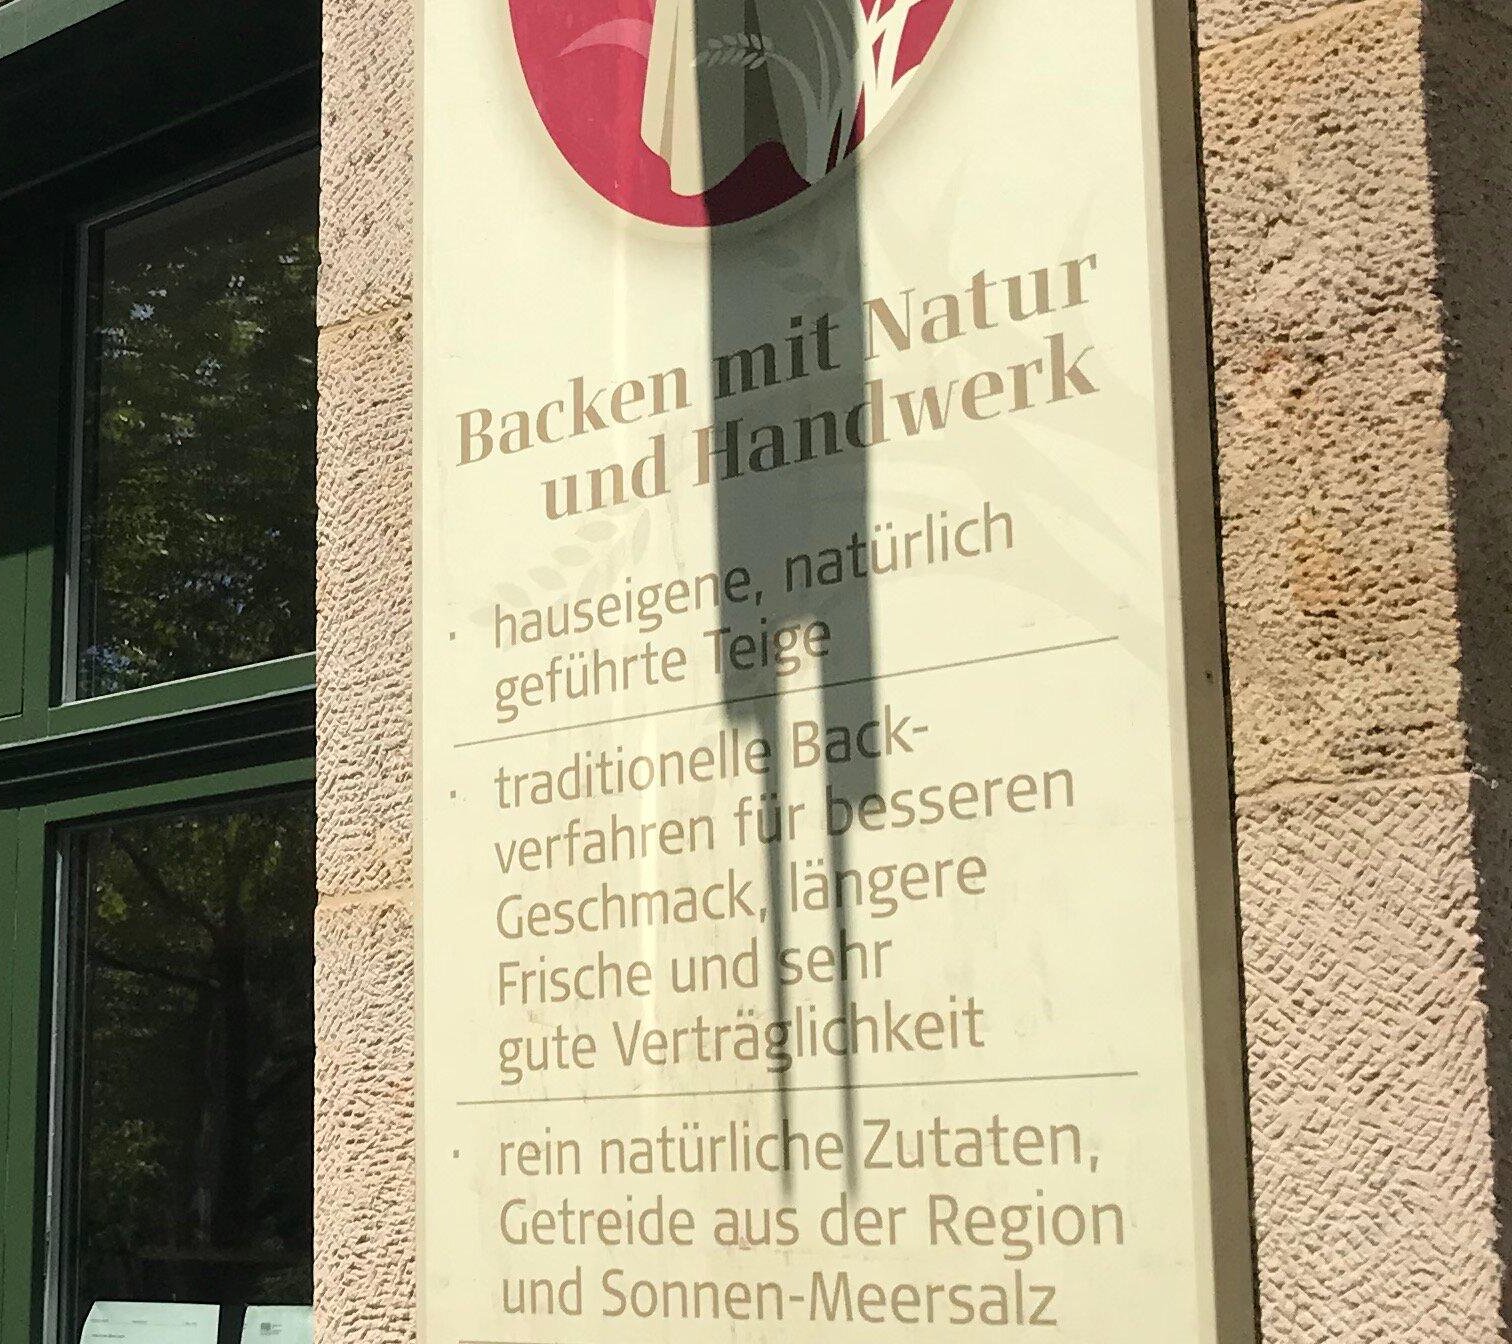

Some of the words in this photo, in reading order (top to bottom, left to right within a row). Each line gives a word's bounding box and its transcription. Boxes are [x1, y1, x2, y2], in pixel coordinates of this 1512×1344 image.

[456, 365, 692, 467] Backen
[713, 311, 842, 400] mit
[862, 253, 1099, 361] Natur
[541, 435, 674, 521] und
[692, 333, 1102, 488] Handwerk
[494, 555, 765, 649] hauseigene,
[785, 501, 1015, 591] natürlich
[494, 641, 688, 724] geführte
[704, 613, 832, 679] Teige
[494, 726, 772, 811] traditionelle
[792, 704, 930, 770] Back-
[494, 805, 716, 874] verfahren
[734, 785, 806, 845] für
[824, 764, 1074, 838] besseren
[496, 869, 768, 940] Geschmack,
[789, 852, 988, 920] längere
[499, 950, 652, 1006] Frische
[669, 937, 759, 991] und
[777, 931, 894, 987] sehr
[498, 1024, 598, 1086] gute
[612, 994, 986, 1074] Verträglichkeit
[498, 1128, 581, 1178] rein
[600, 1117, 844, 1176] natürliche
[861, 1114, 1100, 1175] Zutaten,
[499, 1196, 696, 1247] Getreide
[714, 1205, 800, 1247] aus
[818, 1194, 907, 1248] der
[927, 1193, 1125, 1261] Region
[501, 1266, 583, 1318] und
[600, 1268, 1058, 1328] Sonnen-Meersalz
